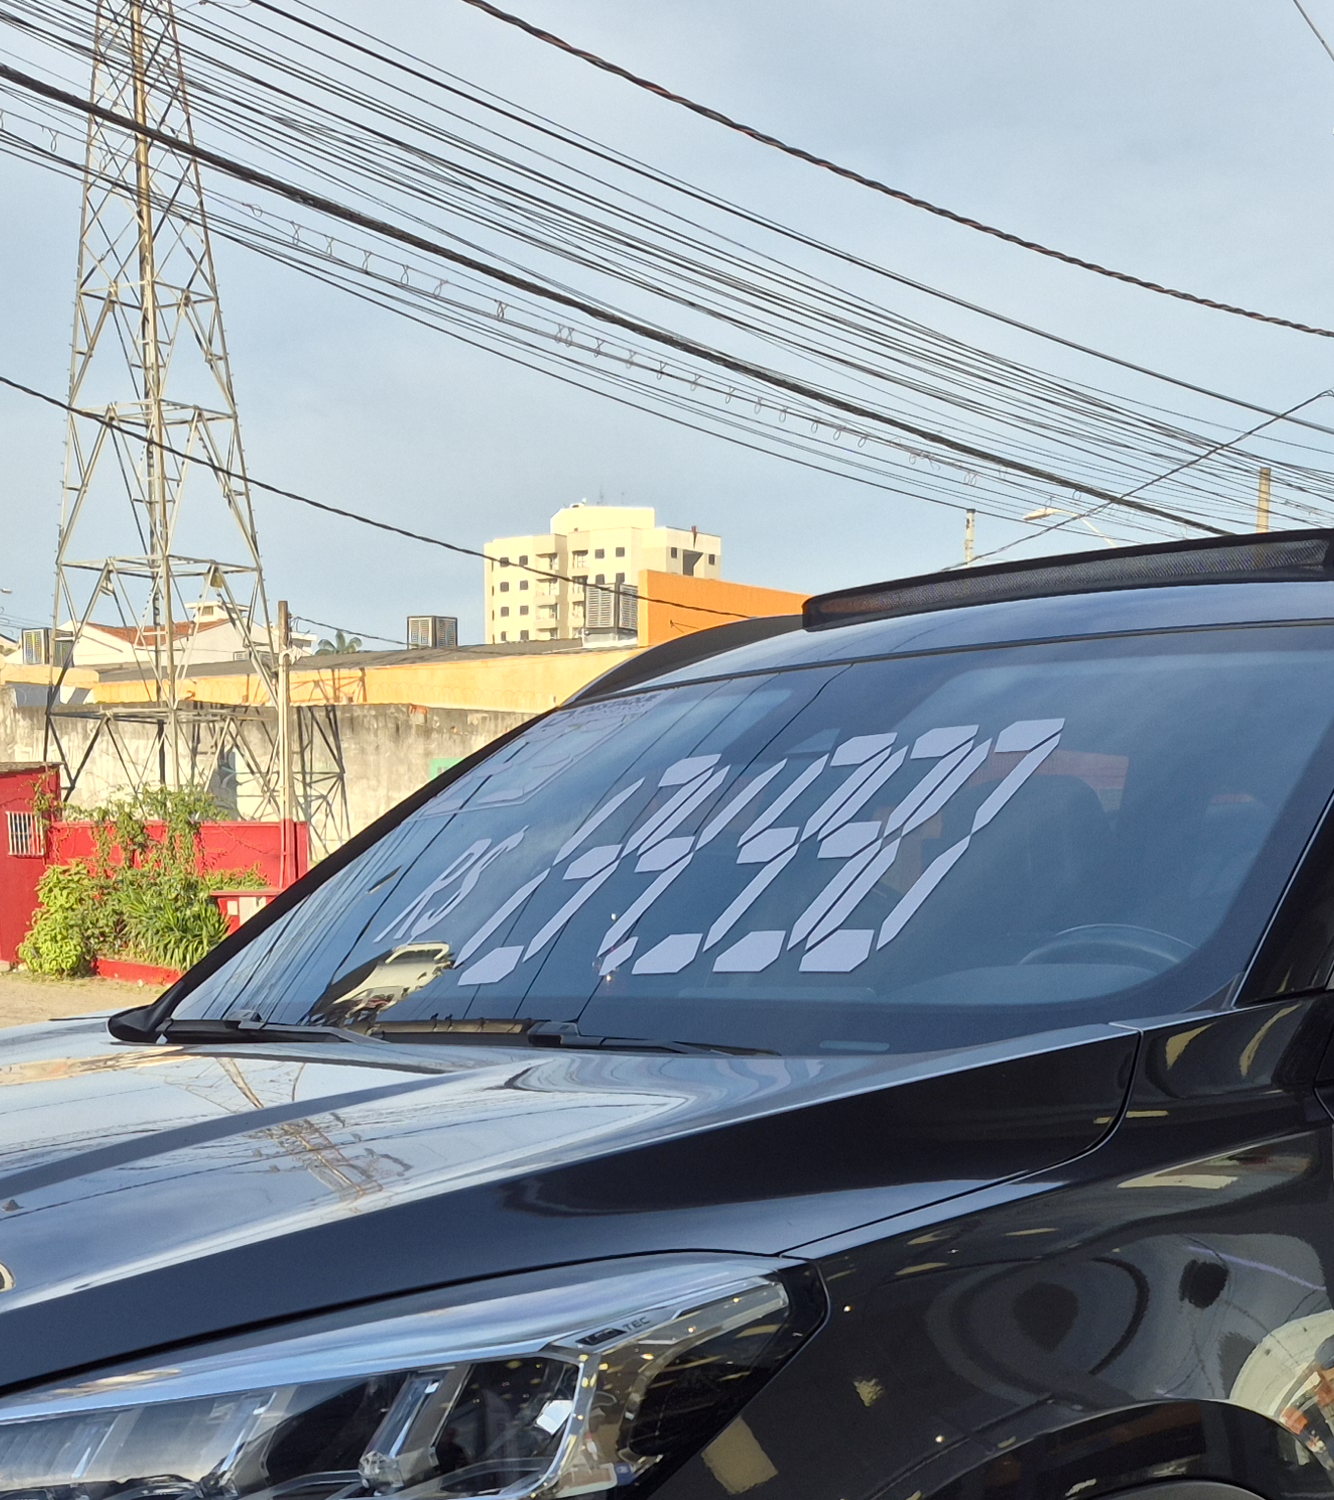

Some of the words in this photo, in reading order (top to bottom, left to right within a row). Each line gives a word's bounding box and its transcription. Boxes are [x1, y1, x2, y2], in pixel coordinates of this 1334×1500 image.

[373, 824, 531, 948] R$
[454, 717, 1066, 986] 134.990
[622, 1316, 651, 1331] TEC
